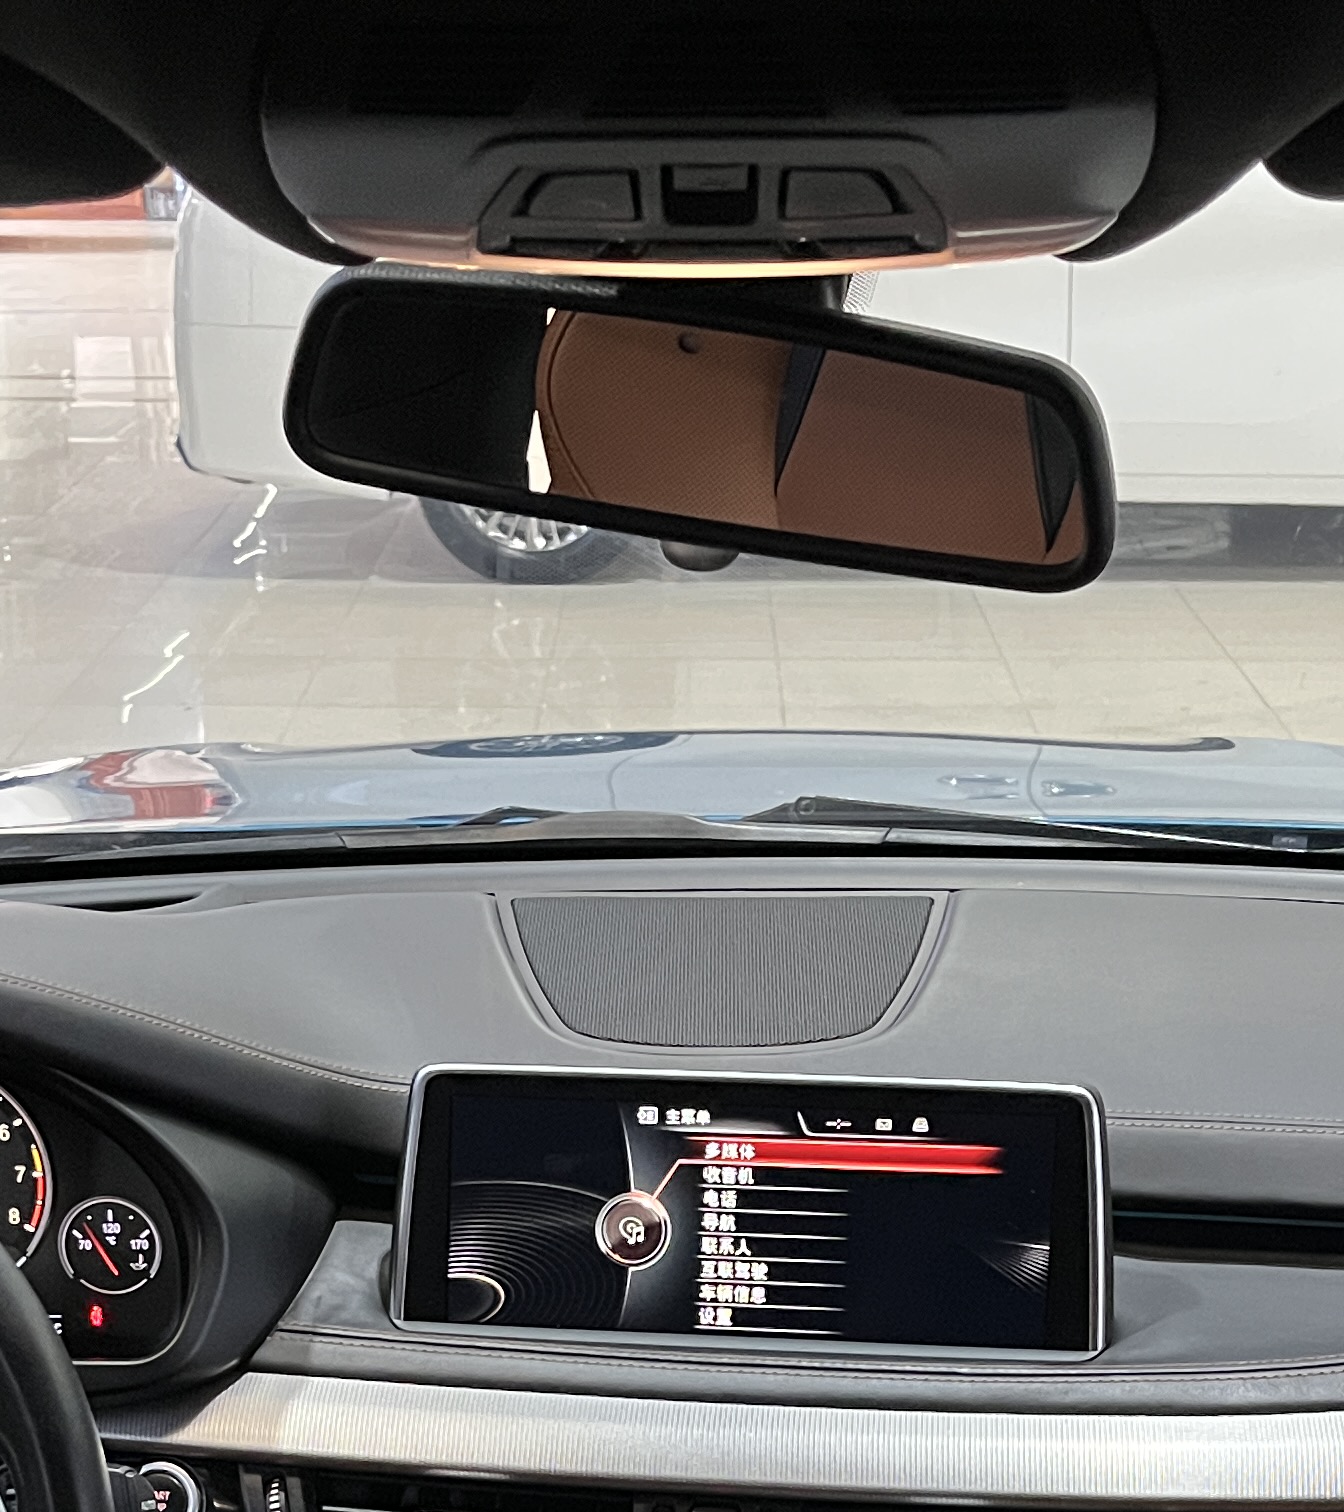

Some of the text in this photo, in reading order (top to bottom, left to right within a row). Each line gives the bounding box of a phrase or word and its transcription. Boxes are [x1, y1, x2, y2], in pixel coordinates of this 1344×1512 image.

[665, 1108, 711, 1125] 主菜单
[704, 1142, 756, 1160] 多媒体
[14, 1165, 27, 1183] 7
[702, 1166, 755, 1185] 收音机
[702, 1189, 737, 1209] 电话
[8, 1207, 21, 1225] 8
[701, 1212, 736, 1232] 导航
[102, 1223, 121, 1235] 120
[78, 1239, 93, 1251] 70
[129, 1239, 150, 1251] 170
[700, 1236, 752, 1256] 联系人
[700, 1260, 769, 1281] 互联驾驶
[698, 1283, 767, 1305] 车辆信息
[698, 1307, 733, 1327] 设置
